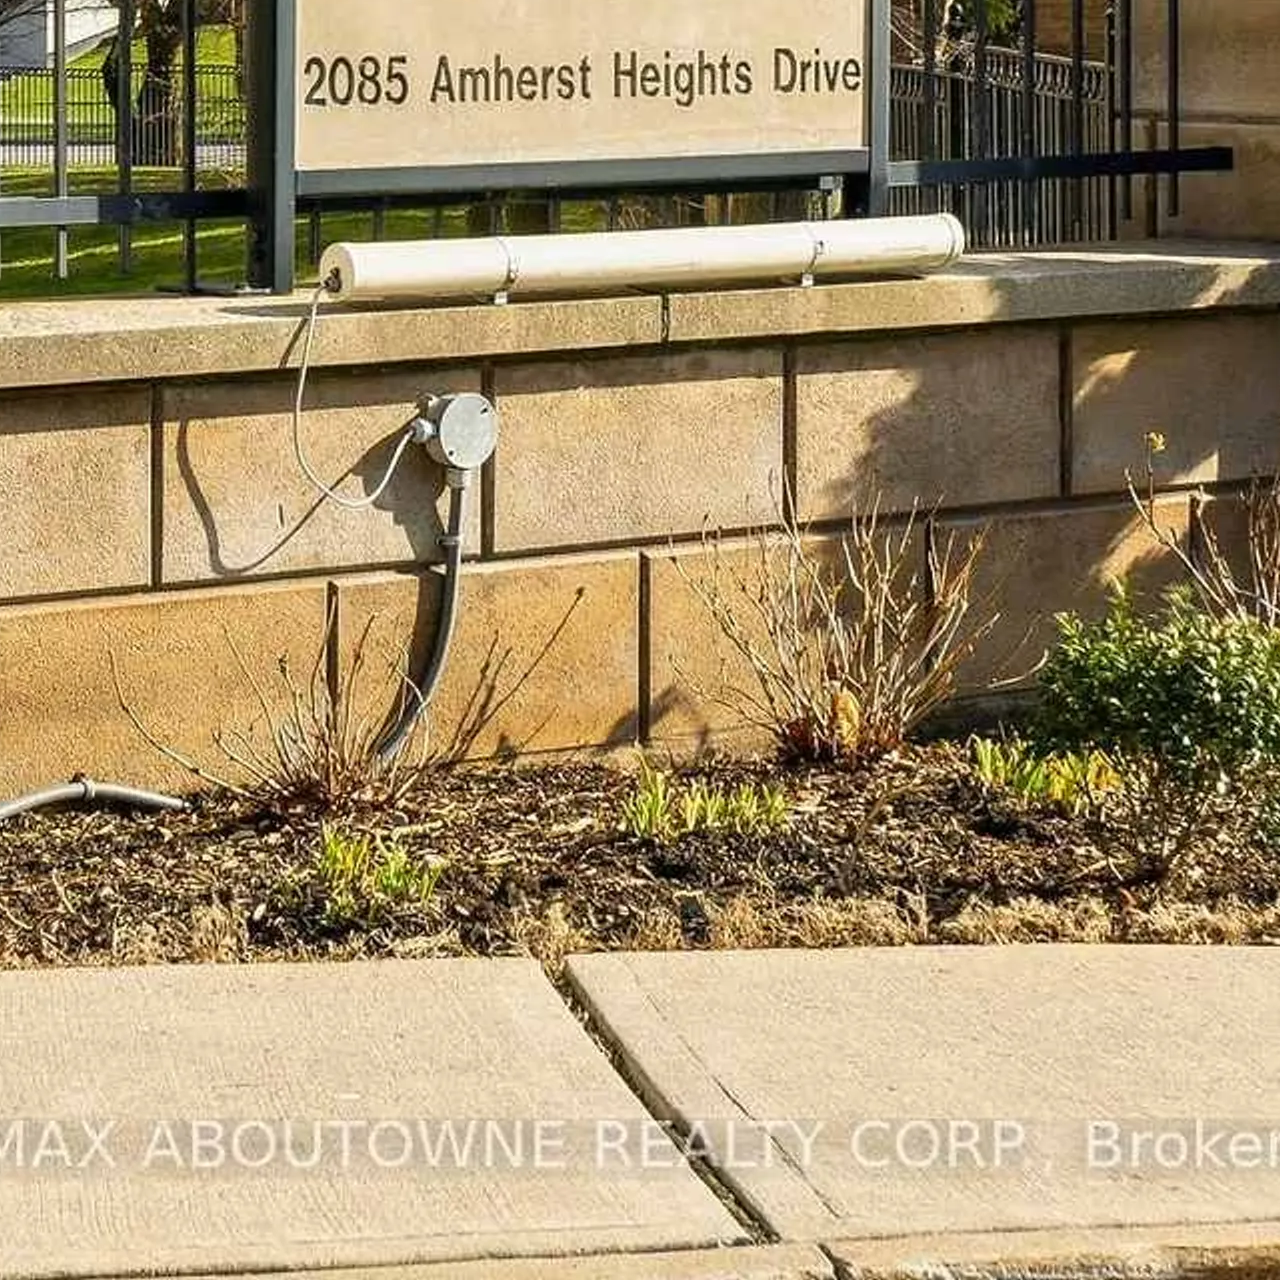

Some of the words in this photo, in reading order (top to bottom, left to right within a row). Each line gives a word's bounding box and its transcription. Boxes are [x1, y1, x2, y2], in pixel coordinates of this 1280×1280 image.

[304, 54, 410, 106] 2085
[430, 54, 592, 102] Amherst
[613, 50, 753, 107] Heights
[773, 47, 863, 93] Drive
